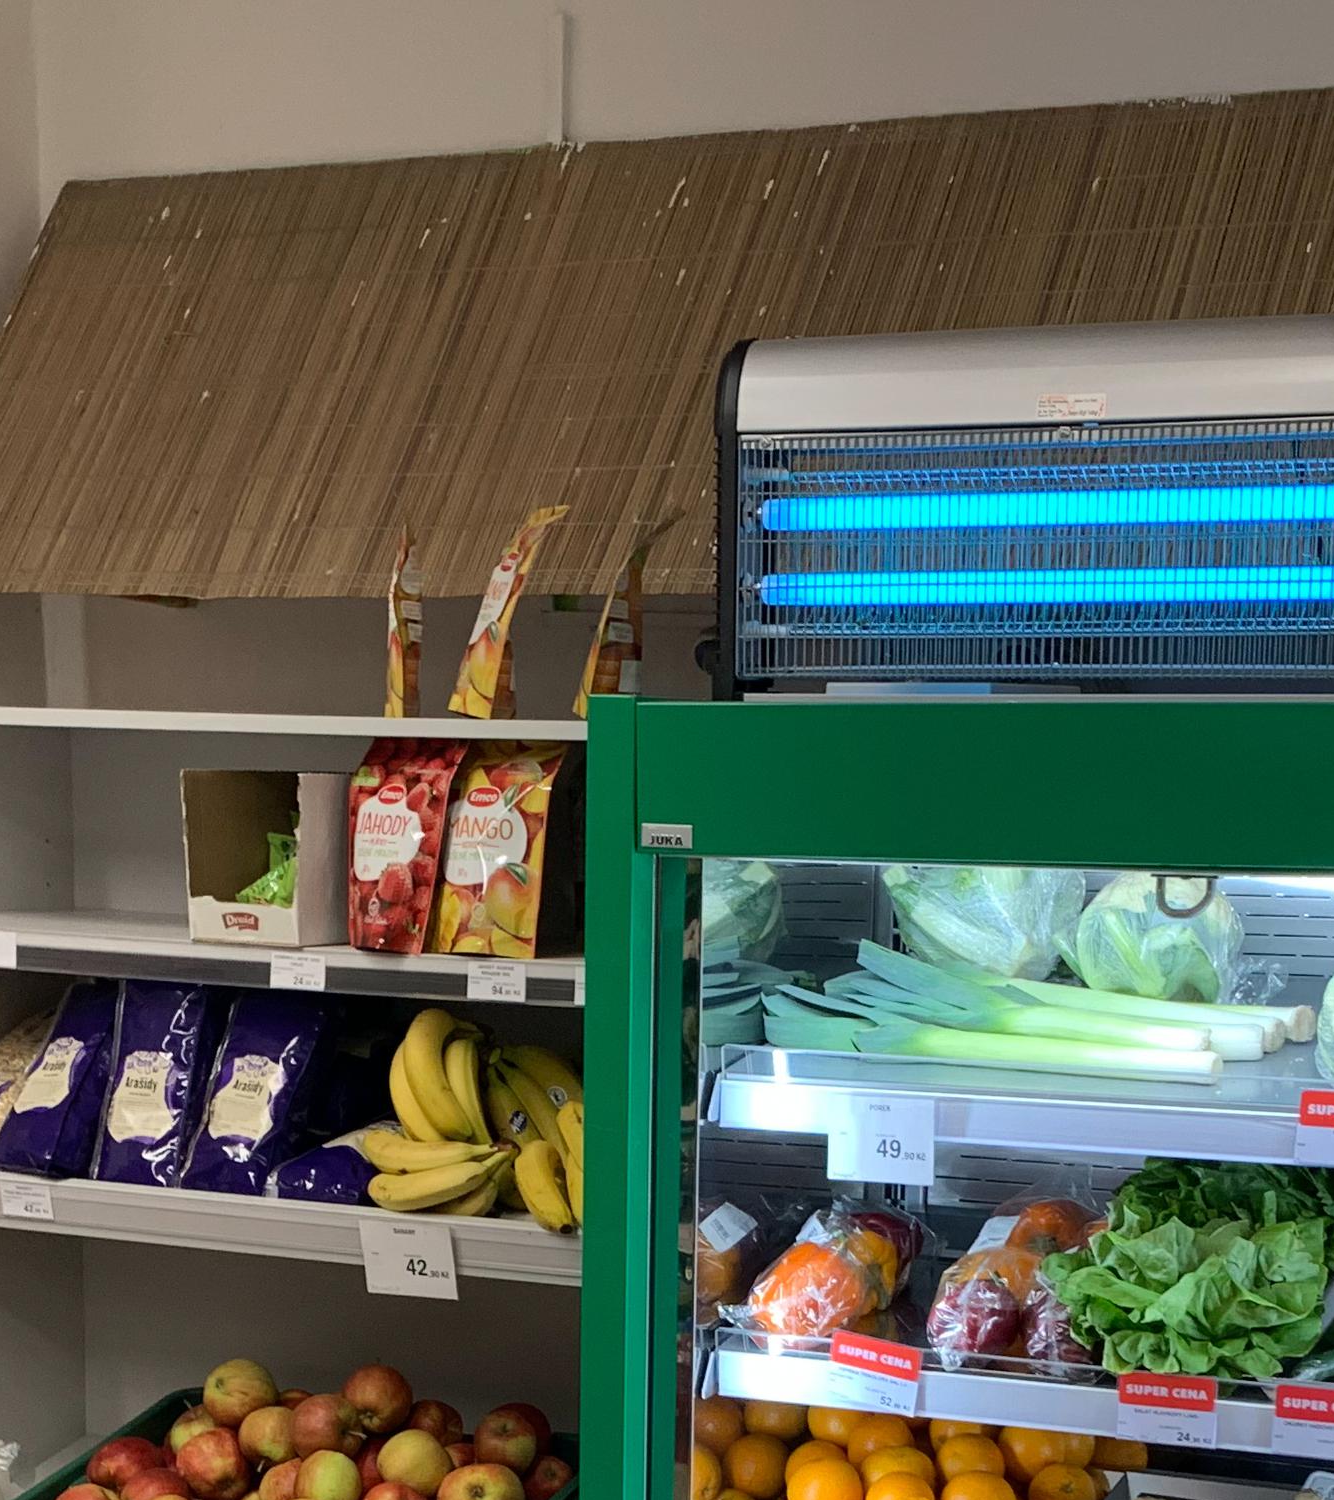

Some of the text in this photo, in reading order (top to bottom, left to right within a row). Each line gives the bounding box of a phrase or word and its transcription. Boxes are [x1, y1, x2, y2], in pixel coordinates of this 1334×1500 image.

[357, 811, 413, 837] JAHODY
[648, 832, 685, 848] JUKA
[223, 912, 259, 928] Druid
[838, 1343, 913, 1371] SUPER CENA
[1124, 1383, 1209, 1402] SUPER CENA
[1282, 1396, 1329, 1413] SUPER
